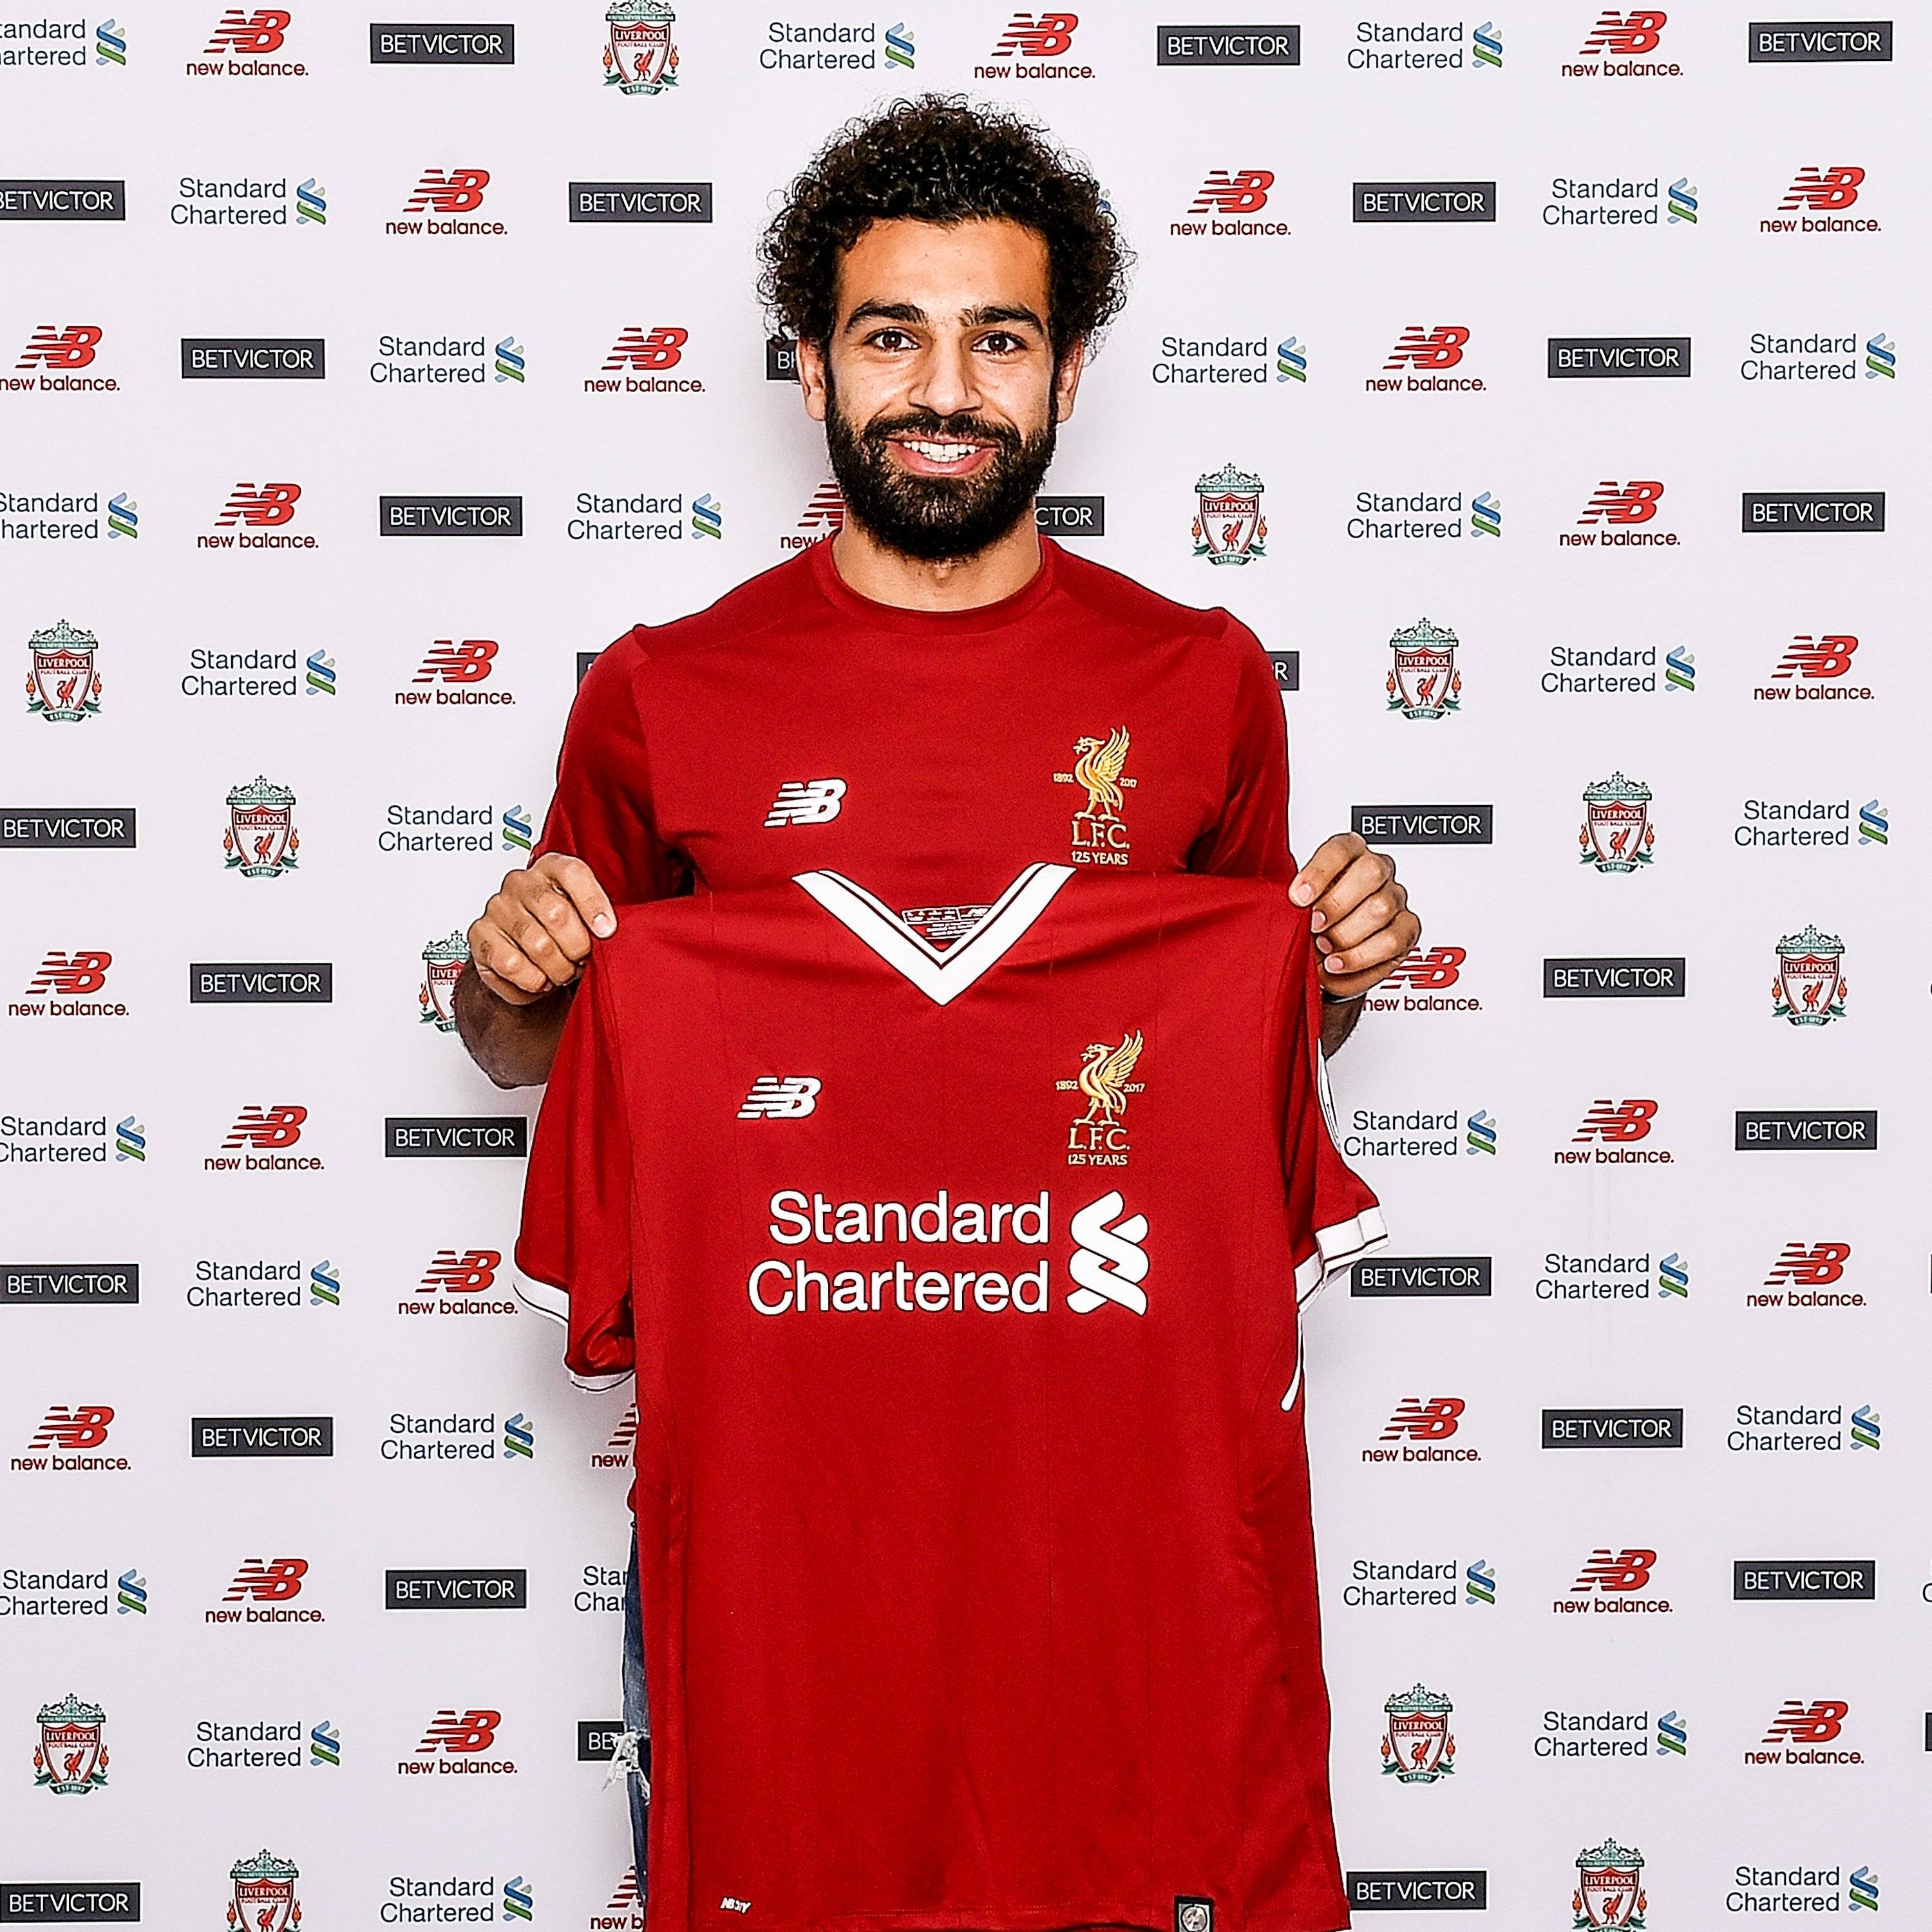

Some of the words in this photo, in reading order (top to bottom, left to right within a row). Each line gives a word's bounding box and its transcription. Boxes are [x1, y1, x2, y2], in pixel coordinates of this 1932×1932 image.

[616, 31, 666, 40] LIVERPOOL
[769, 23, 874, 43] Standard
[1358, 22, 1462, 42] Standard
[381, 34, 502, 53] BETVICTOR
[1168, 36, 1289, 55] BETVICTOR
[1760, 33, 1880, 52] BETVICTOR
[187, 63, 223, 75] new
[229, 60, 308, 75] balance.
[761, 49, 875, 69] Chartered
[1348, 49, 1462, 68] Chartered
[1562, 65, 1598, 76] new
[1604, 61, 1683, 76] balance.
[180, 178, 285, 198] Standard
[1553, 178, 1657, 198] Standard
[580, 193, 701, 212] BETVICTOR
[171, 204, 286, 224] Chartered
[1543, 205, 1657, 225] Chartered
[386, 222, 422, 234] new
[428, 219, 507, 234] balance.
[1171, 223, 1207, 235] new
[1213, 220, 1291, 235] balance.
[1761, 220, 1797, 232] new
[1803, 216, 1881, 232] balance.
[379, 336, 484, 356] Standard
[1162, 337, 1266, 356] Standard
[1751, 334, 1855, 353] Standard
[193, 350, 314, 368] BETVICTOR
[1559, 348, 1679, 367] BETVICTOR
[371, 363, 484, 383] Chartered
[1153, 364, 1267, 383] Chartered
[1741, 360, 1855, 380] Chartered
[585, 380, 621, 392] new
[627, 377, 705, 392] balance.
[1367, 379, 1402, 391] new
[1408, 376, 1486, 391] balance.
[577, 493, 681, 513] Standard
[1205, 502, 1254, 511] LIVERPOOL
[1357, 492, 1461, 512] Standard
[391, 507, 511, 525] BETVICTOR
[1754, 503, 1873, 522] BETVICTOR
[568, 520, 681, 539] Chartered
[1348, 518, 1461, 538] Chartered
[198, 536, 234, 547] new
[240, 533, 318, 548] balance.
[39, 658, 89, 667] LIVERPOOL
[191, 649, 296, 669] Standard
[1551, 647, 1655, 666] Standard
[182, 676, 296, 695] Chartered
[1542, 672, 1655, 692] Chartered
[395, 693, 431, 705] new
[437, 689, 515, 705] balance.
[388, 805, 492, 824] Standard
[1593, 810, 1642, 819] LIVERPOOL
[1745, 800, 1849, 819] Standard
[5, 819, 124, 837] BETVICTOR
[236, 815, 286, 824] LIVERPOOL
[1362, 816, 1481, 834] BETVICTOR
[379, 831, 492, 851] Chartered
[1072, 820, 1130, 849] L.F.C.
[1735, 826, 1848, 846] Chartered
[1072, 851, 1090, 863] 125
[1092, 852, 1128, 865] YEARS
[1785, 963, 1835, 972] LIVERPOOL
[202, 974, 320, 992] BETVICTOR
[1555, 969, 1673, 987] BETVICTOR
[9, 1004, 45, 1016] new
[50, 1001, 129, 1016] balance.
[1056, 1081, 1078, 1090] 1892
[1123, 1083, 1145, 1093] 2017
[1, 1116, 106, 1135] Standard
[1354, 1110, 1457, 1130] Standard
[396, 1128, 515, 1146] BETVICTOR
[1068, 1128, 1131, 1150] L.F.C.
[1344, 1137, 1457, 1156] Chartered
[205, 1159, 241, 1170] new
[246, 1155, 324, 1170] balance.
[1068, 1154, 1086, 1164] 125
[1088, 1155, 1128, 1165] YEARS
[1555, 1152, 1591, 1164] new
[1596, 1148, 1674, 1163] balance.
[770, 1191, 1048, 1244] Standard
[196, 1261, 300, 1280] Standard
[1362, 1267, 1479, 1286] BETVICTOR
[8, 1275, 127, 1293] BETVICTOR
[749, 1260, 1048, 1314] Chartered
[187, 1287, 300, 1306] Chartered
[1747, 1295, 1783, 1306] new
[1788, 1291, 1866, 1306] balance.
[390, 1414, 494, 1433] Standard
[1553, 1419, 1671, 1437] BETVICTOR
[203, 1428, 321, 1446] BETVICTOR
[381, 1439, 494, 1459] Chartered
[1363, 1450, 1398, 1462] new
[1403, 1446, 1481, 1461] balance.
[3, 1569, 107, 1589] Standard
[1353, 1560, 1456, 1580] Standard
[1745, 1571, 1863, 1589] BETVICTOR
[1344, 1586, 1455, 1605] Chartered
[206, 1611, 242, 1623] new
[247, 1607, 325, 1622] balance.
[1394, 1721, 1443, 1730] LIVERPOOL
[1544, 1711, 1647, 1730] Standard
[197, 1721, 300, 1741] Standard
[1535, 1737, 1647, 1756] Chartered
[188, 1747, 300, 1767] Chartered
[1745, 1752, 1781, 1764] new
[1786, 1749, 1864, 1764] balance.
[399, 1763, 435, 1774] new
[440, 1759, 517, 1774] balance.
[1586, 1876, 1634, 1885] LIVERPOOL
[1736, 1866, 1839, 1886] Standard
[1358, 1882, 1475, 1900] BETVICTOR
[10, 1893, 128, 1911] BETVICTOR
[1727, 1892, 1839, 1911] Chartered
